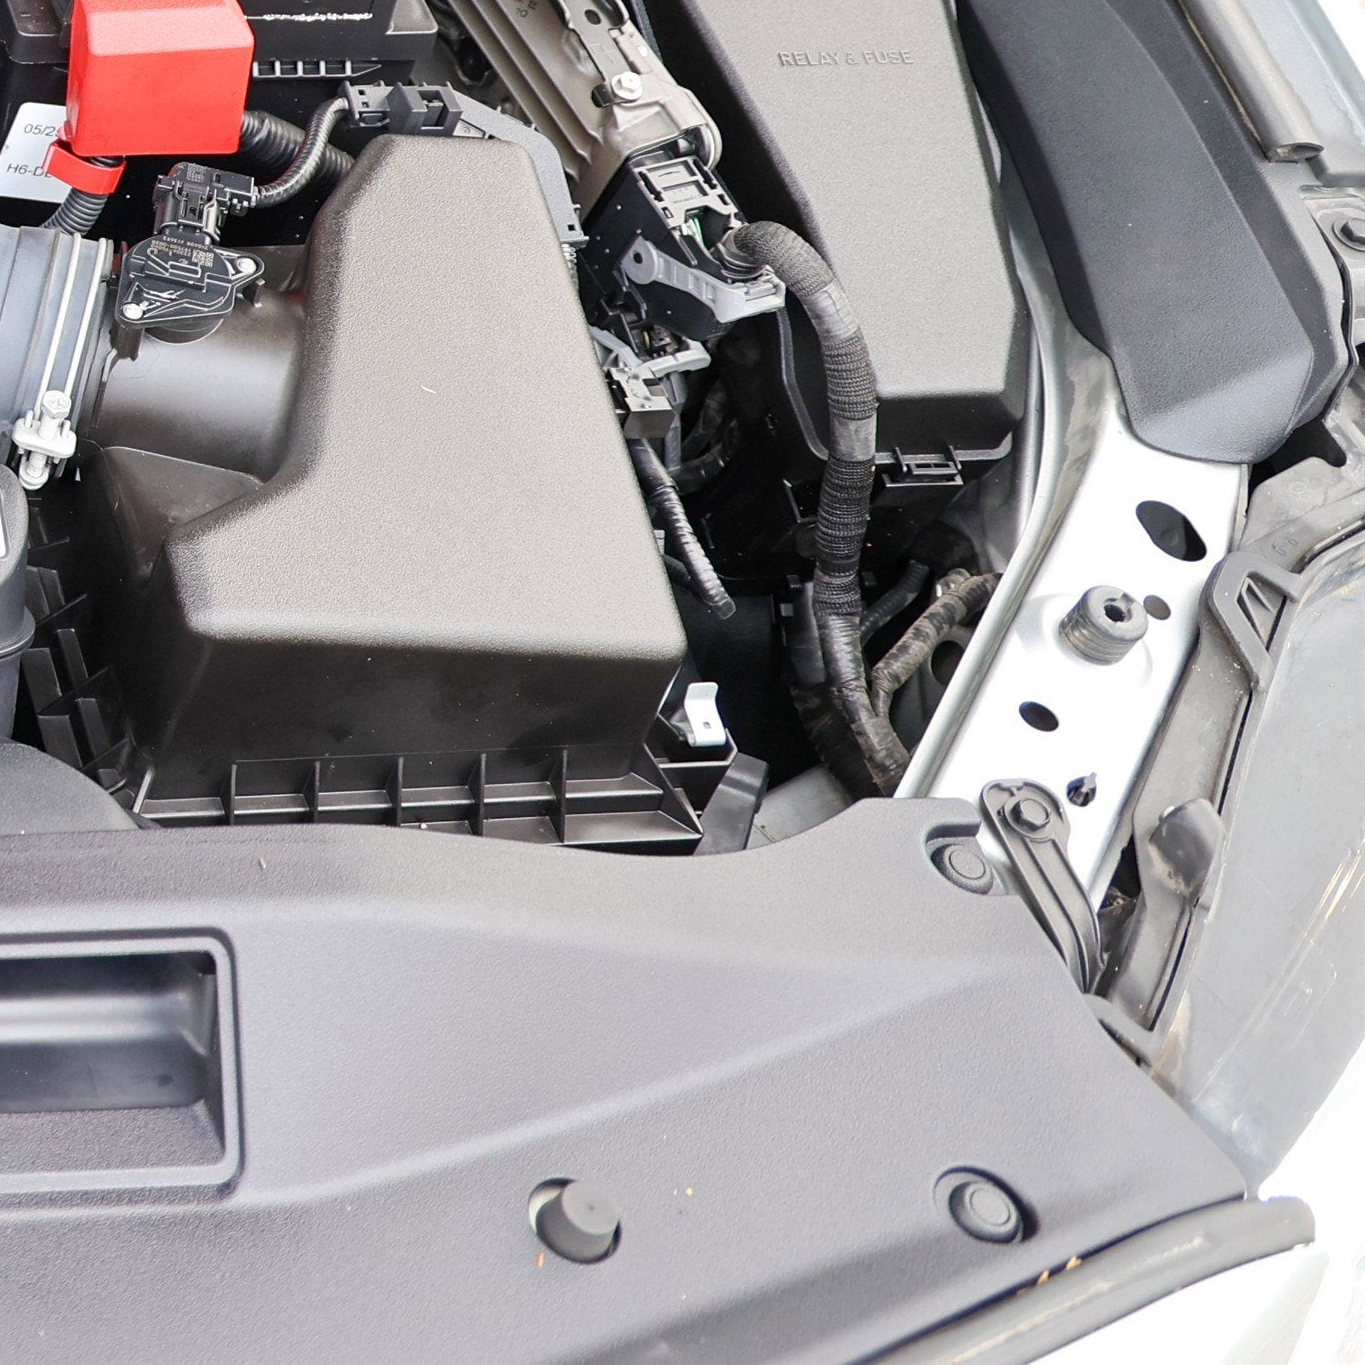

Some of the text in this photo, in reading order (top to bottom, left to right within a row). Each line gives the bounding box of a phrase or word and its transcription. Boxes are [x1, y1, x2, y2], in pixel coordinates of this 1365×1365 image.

[776, 51, 840, 67] RELAY
[863, 49, 915, 65] FUSE
[23, 123, 59, 138] 05/2
